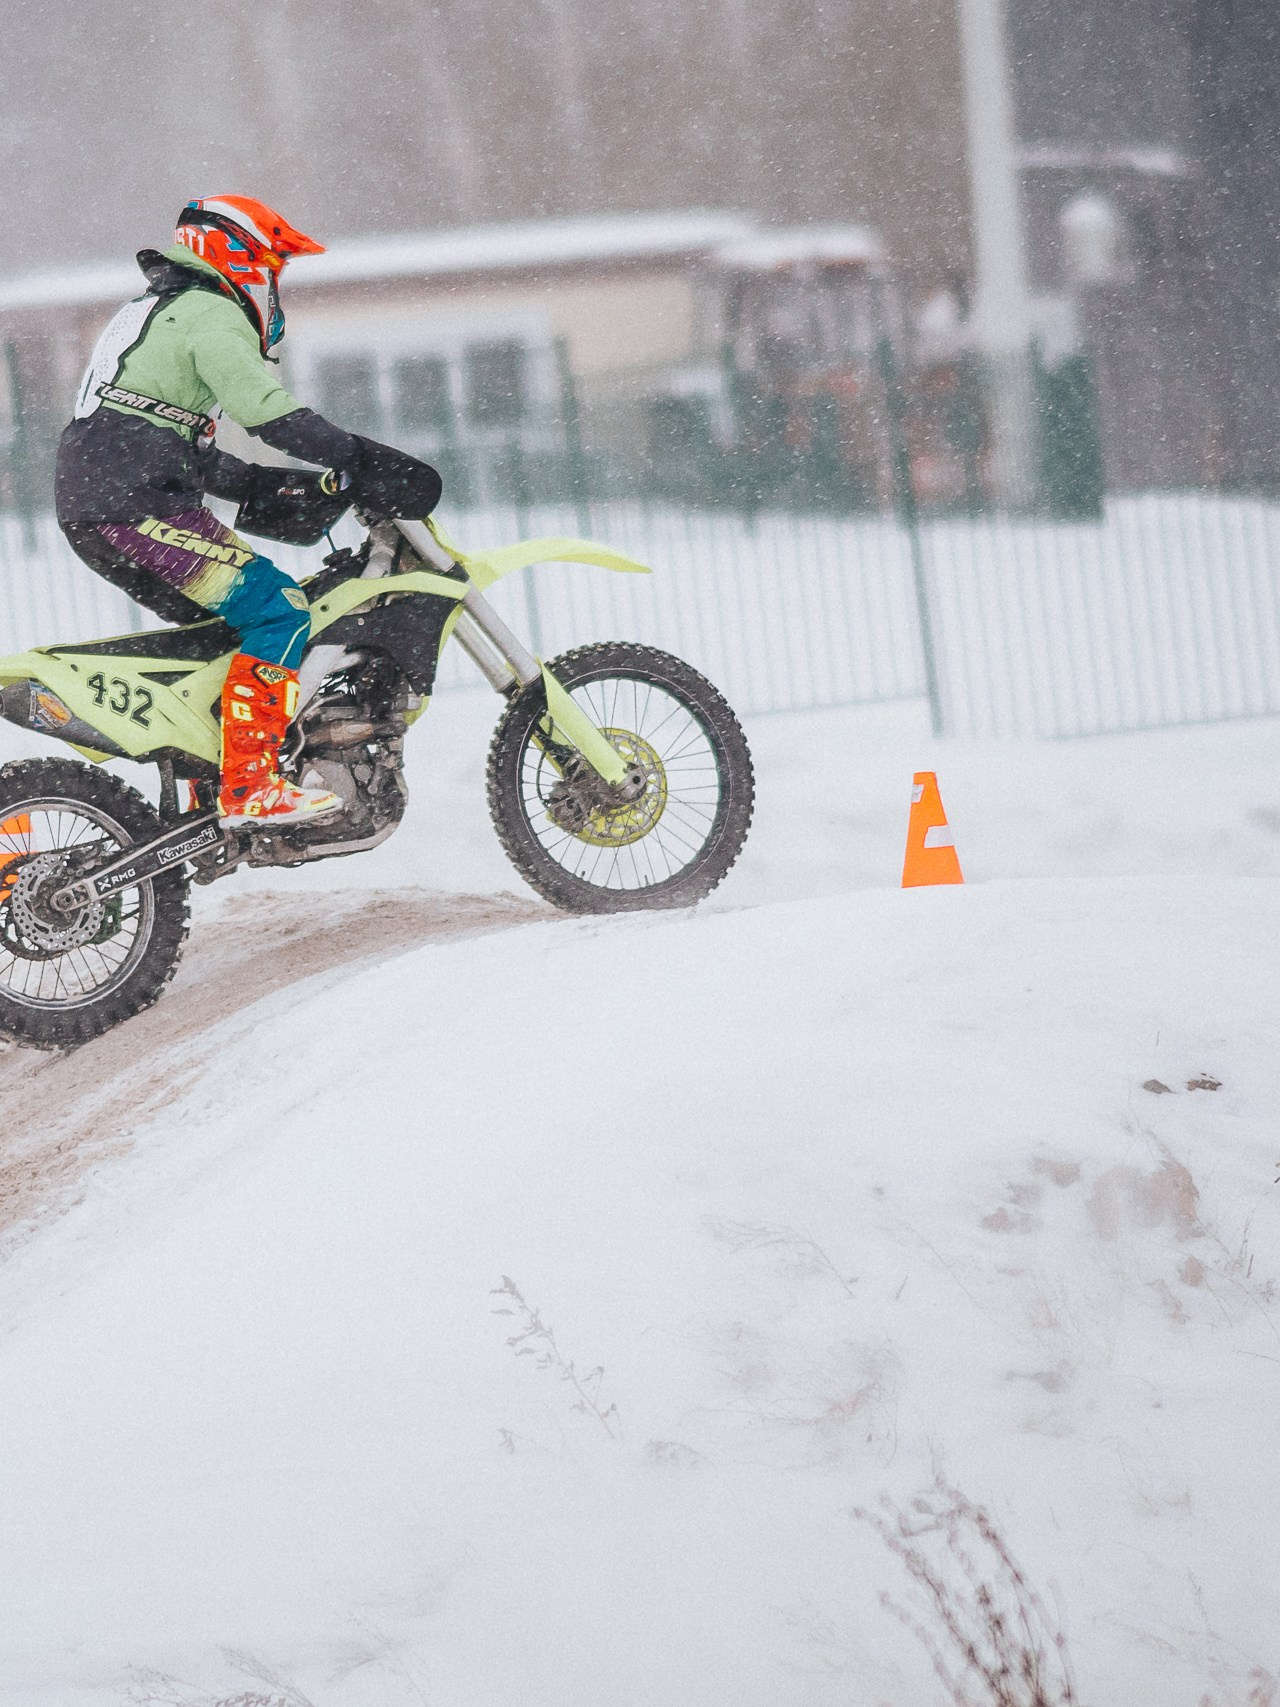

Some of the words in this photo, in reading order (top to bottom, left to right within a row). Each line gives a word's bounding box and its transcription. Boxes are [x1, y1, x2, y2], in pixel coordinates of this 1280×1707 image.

[137, 518, 255, 569] KENNY
[87, 671, 154, 731] 432
[157, 825, 218, 865] Kawasaki
